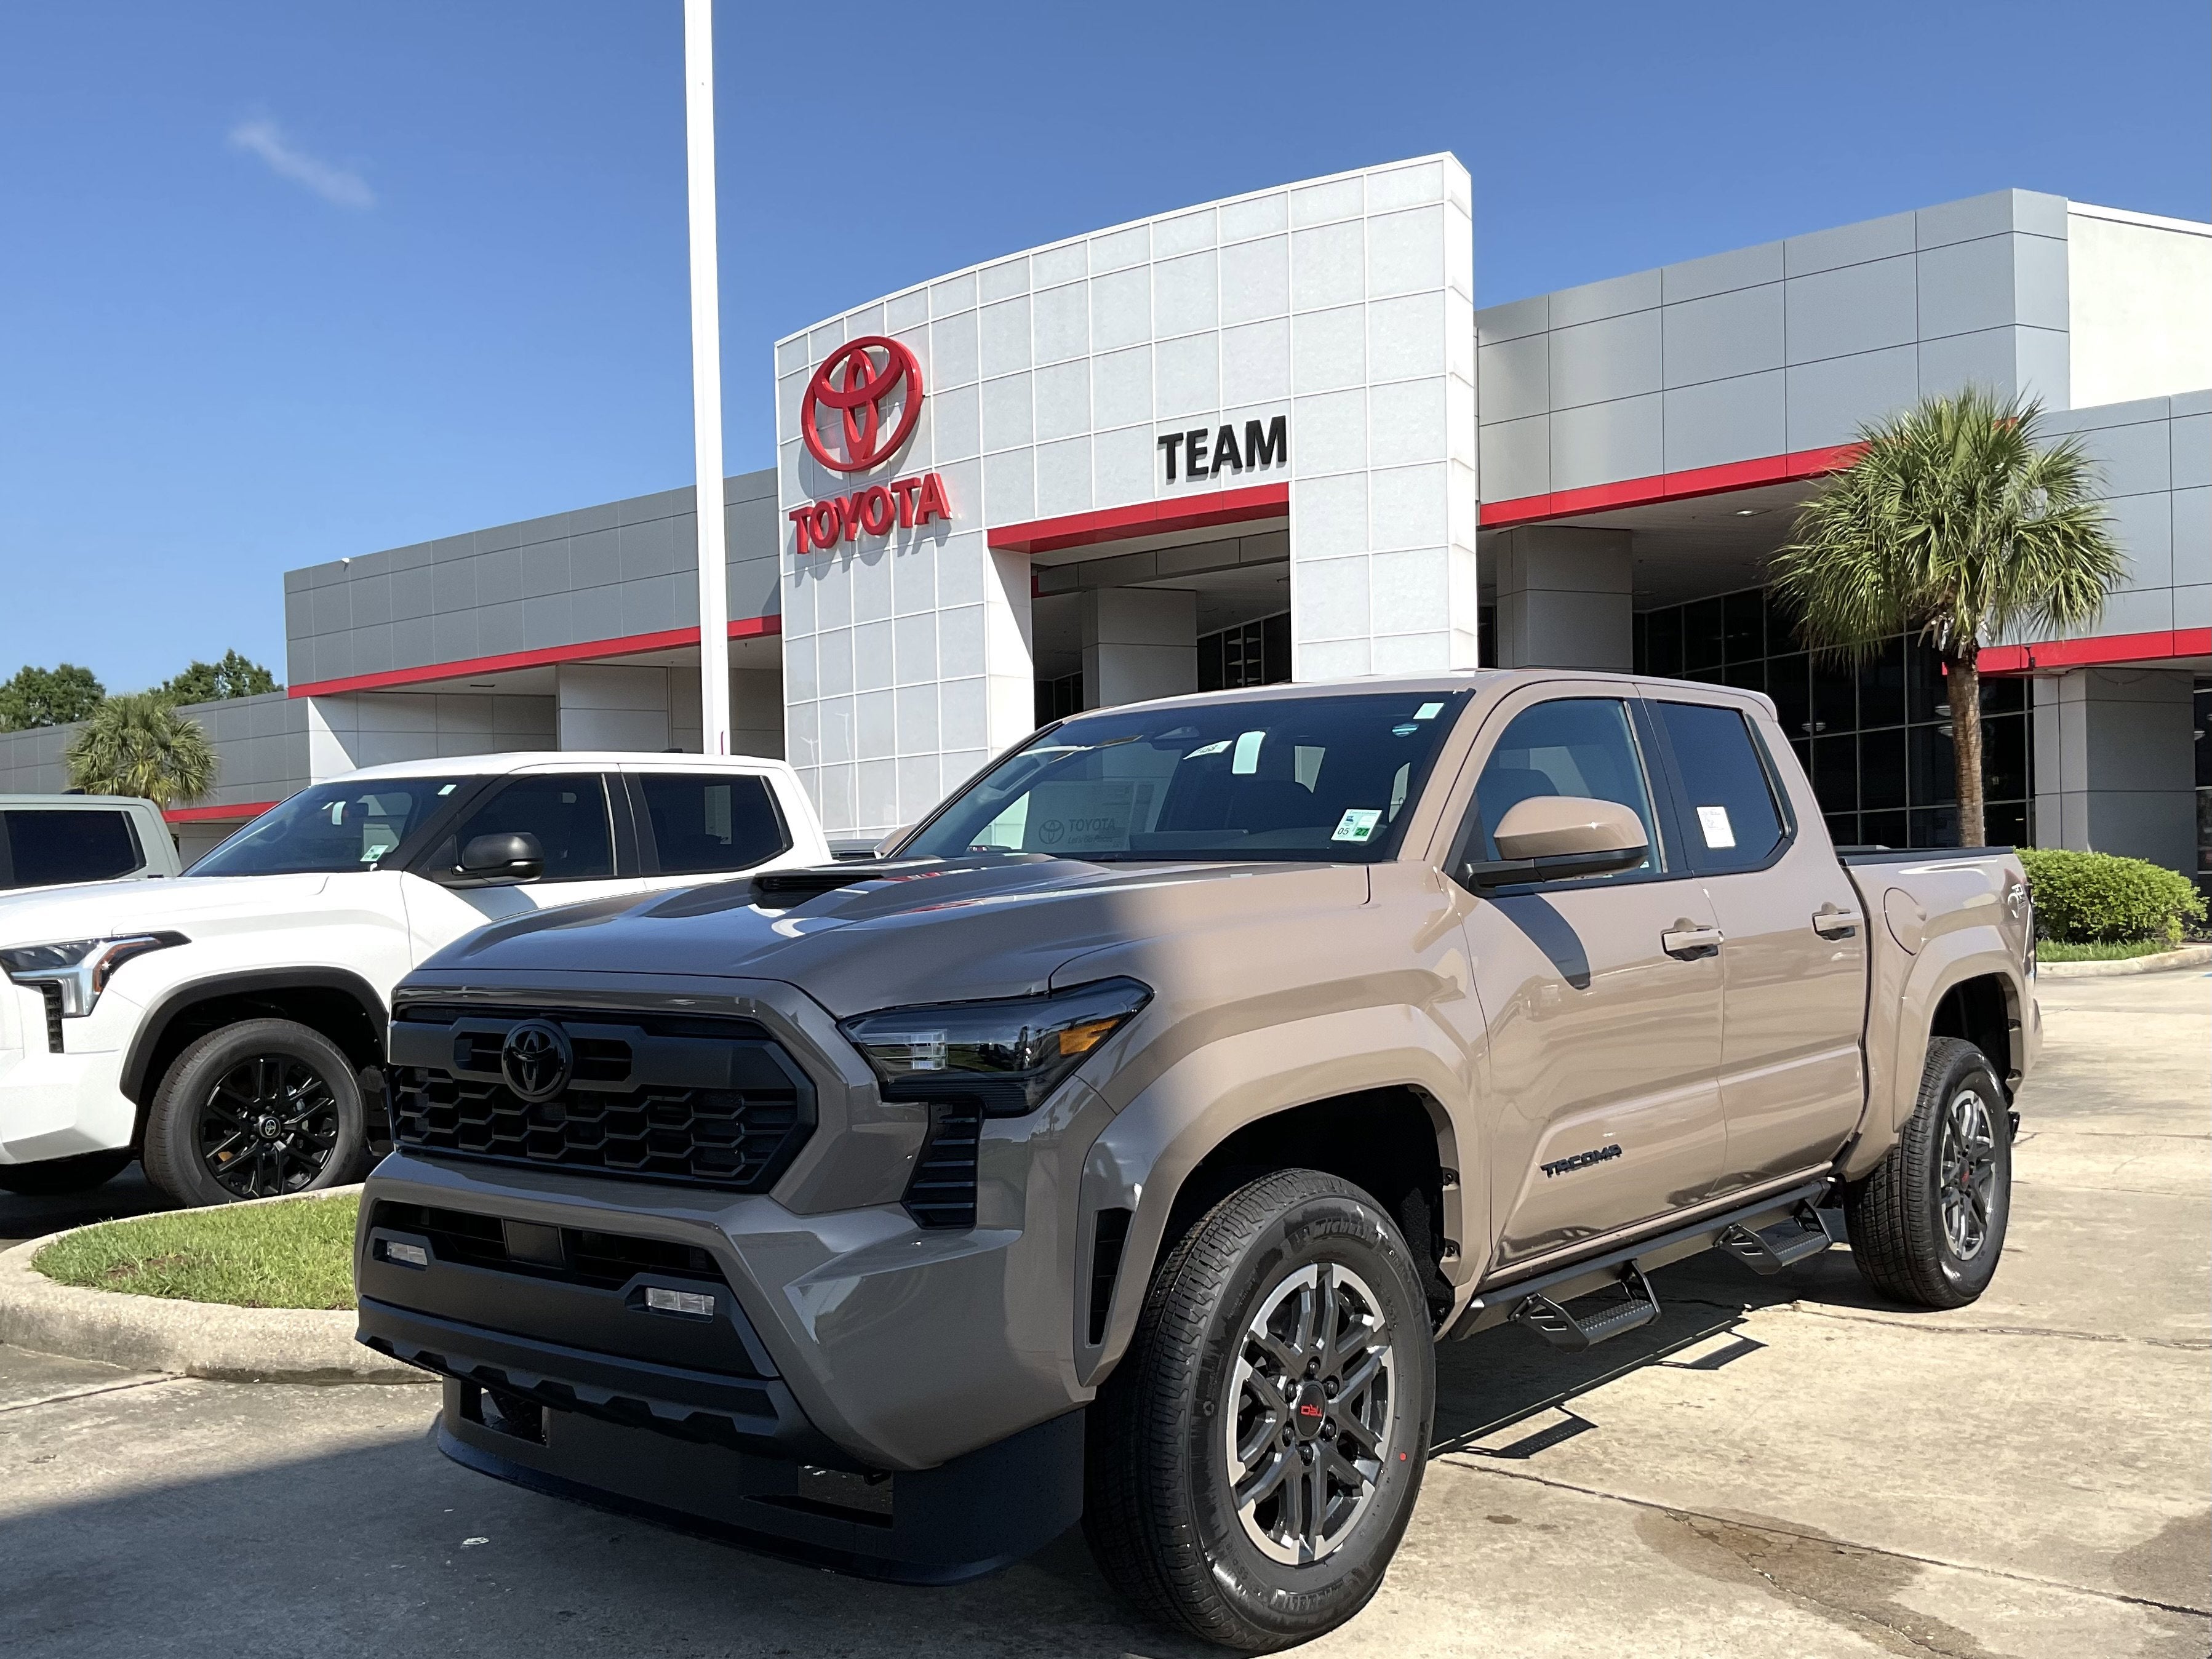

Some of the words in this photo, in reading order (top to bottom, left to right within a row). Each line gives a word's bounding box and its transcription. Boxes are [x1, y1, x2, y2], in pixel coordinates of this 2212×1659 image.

[1158, 415, 1287, 479] TEAM
[789, 473, 952, 554] TOYOTA
[1068, 817, 1116, 832] TOYOTA
[1540, 1144, 1623, 1178] TACOMA
[1301, 1404, 1322, 1418] TRD
